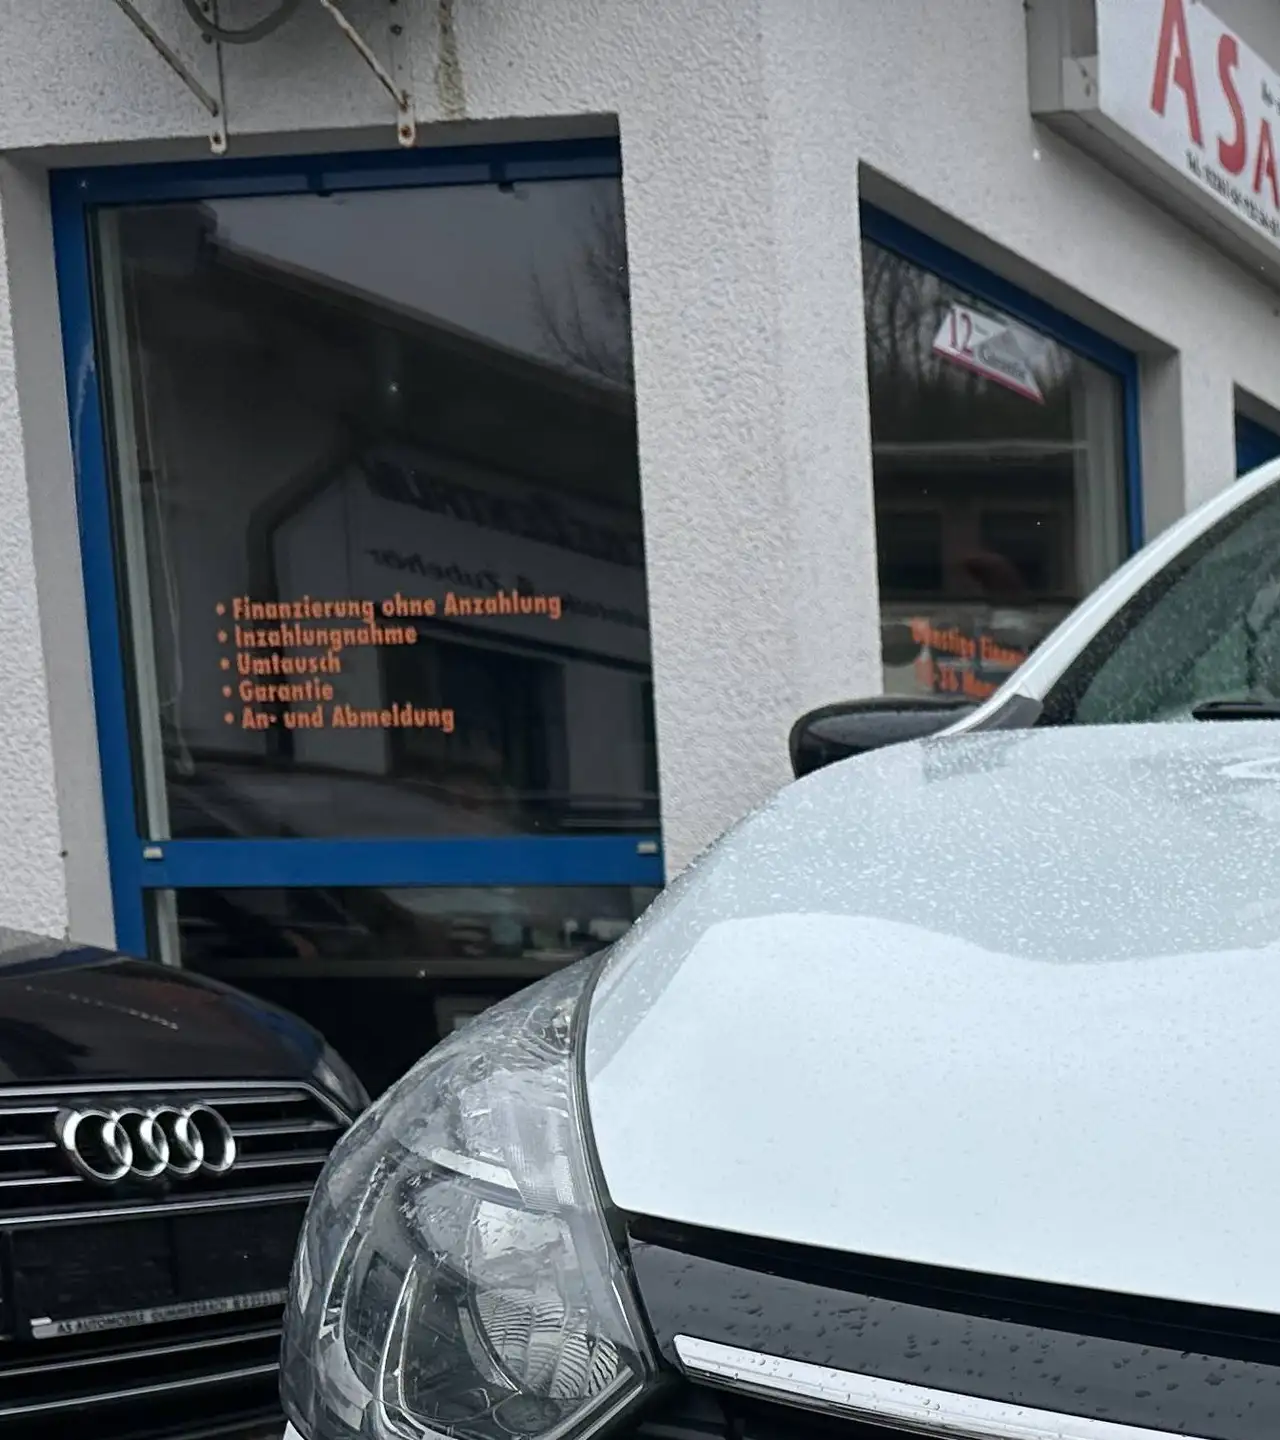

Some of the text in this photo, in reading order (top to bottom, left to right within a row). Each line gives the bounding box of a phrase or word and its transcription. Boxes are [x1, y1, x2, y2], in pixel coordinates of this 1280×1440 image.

[949, 308, 973, 354] 12
[233, 595, 375, 625] Finanzierung
[382, 592, 437, 618] ohne
[444, 590, 562, 620] Anzahlung
[235, 624, 418, 652] Inzahlungnahme
[237, 652, 342, 674] Umtausch
[239, 677, 334, 702] Garantie
[242, 703, 455, 733] An- und Abmeldung
